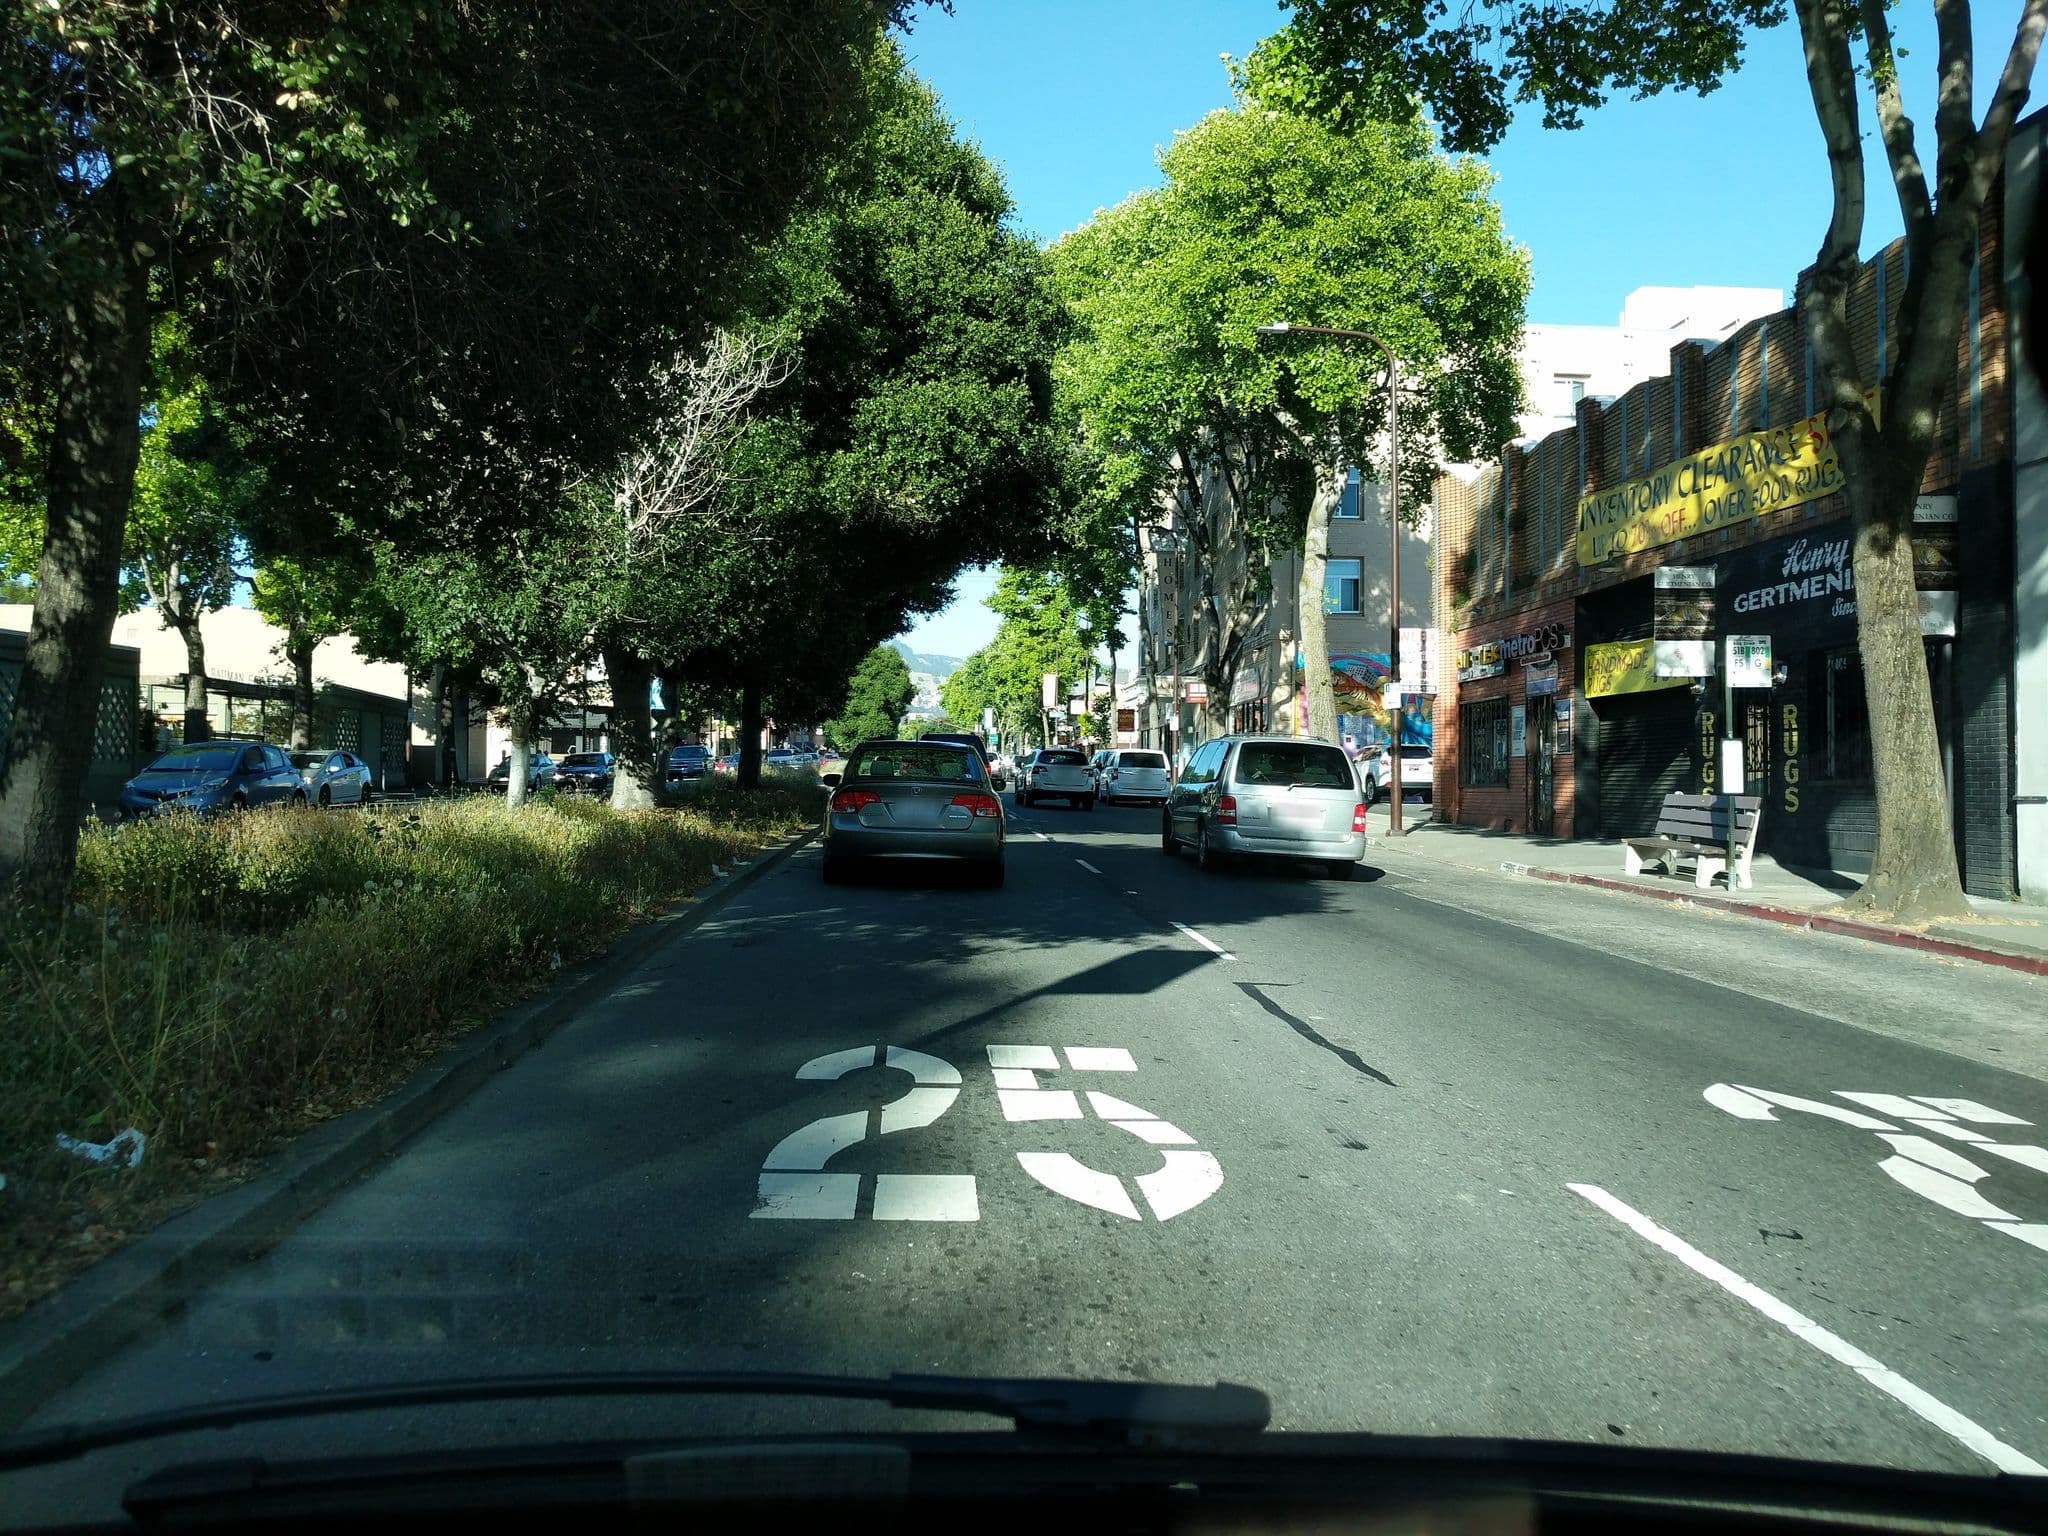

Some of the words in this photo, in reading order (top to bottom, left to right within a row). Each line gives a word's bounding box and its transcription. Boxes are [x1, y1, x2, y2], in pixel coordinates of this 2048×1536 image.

[1580, 471, 1672, 531] INVENTORY
[1678, 426, 1801, 498] CLEARANCE
[1610, 528, 1628, 549] TO
[1704, 489, 1746, 525] OVER
[1752, 474, 1791, 511] 5000
[1796, 458, 1842, 497] RUG
[1782, 538, 1850, 578] Henry
[1163, 557, 1175, 638] HOMES
[1733, 568, 1855, 613] GERTMENI
[1831, 597, 1858, 617] Sinc
[1587, 650, 1649, 676] HANDMADE
[1732, 646, 1745, 655] 51B
[1751, 646, 1765, 655] 802
[1754, 658, 1762, 668] G
[1588, 675, 1613, 696] RUGS
[1783, 704, 1799, 813] RUGS
[747, 1043, 1225, 1223] 25
